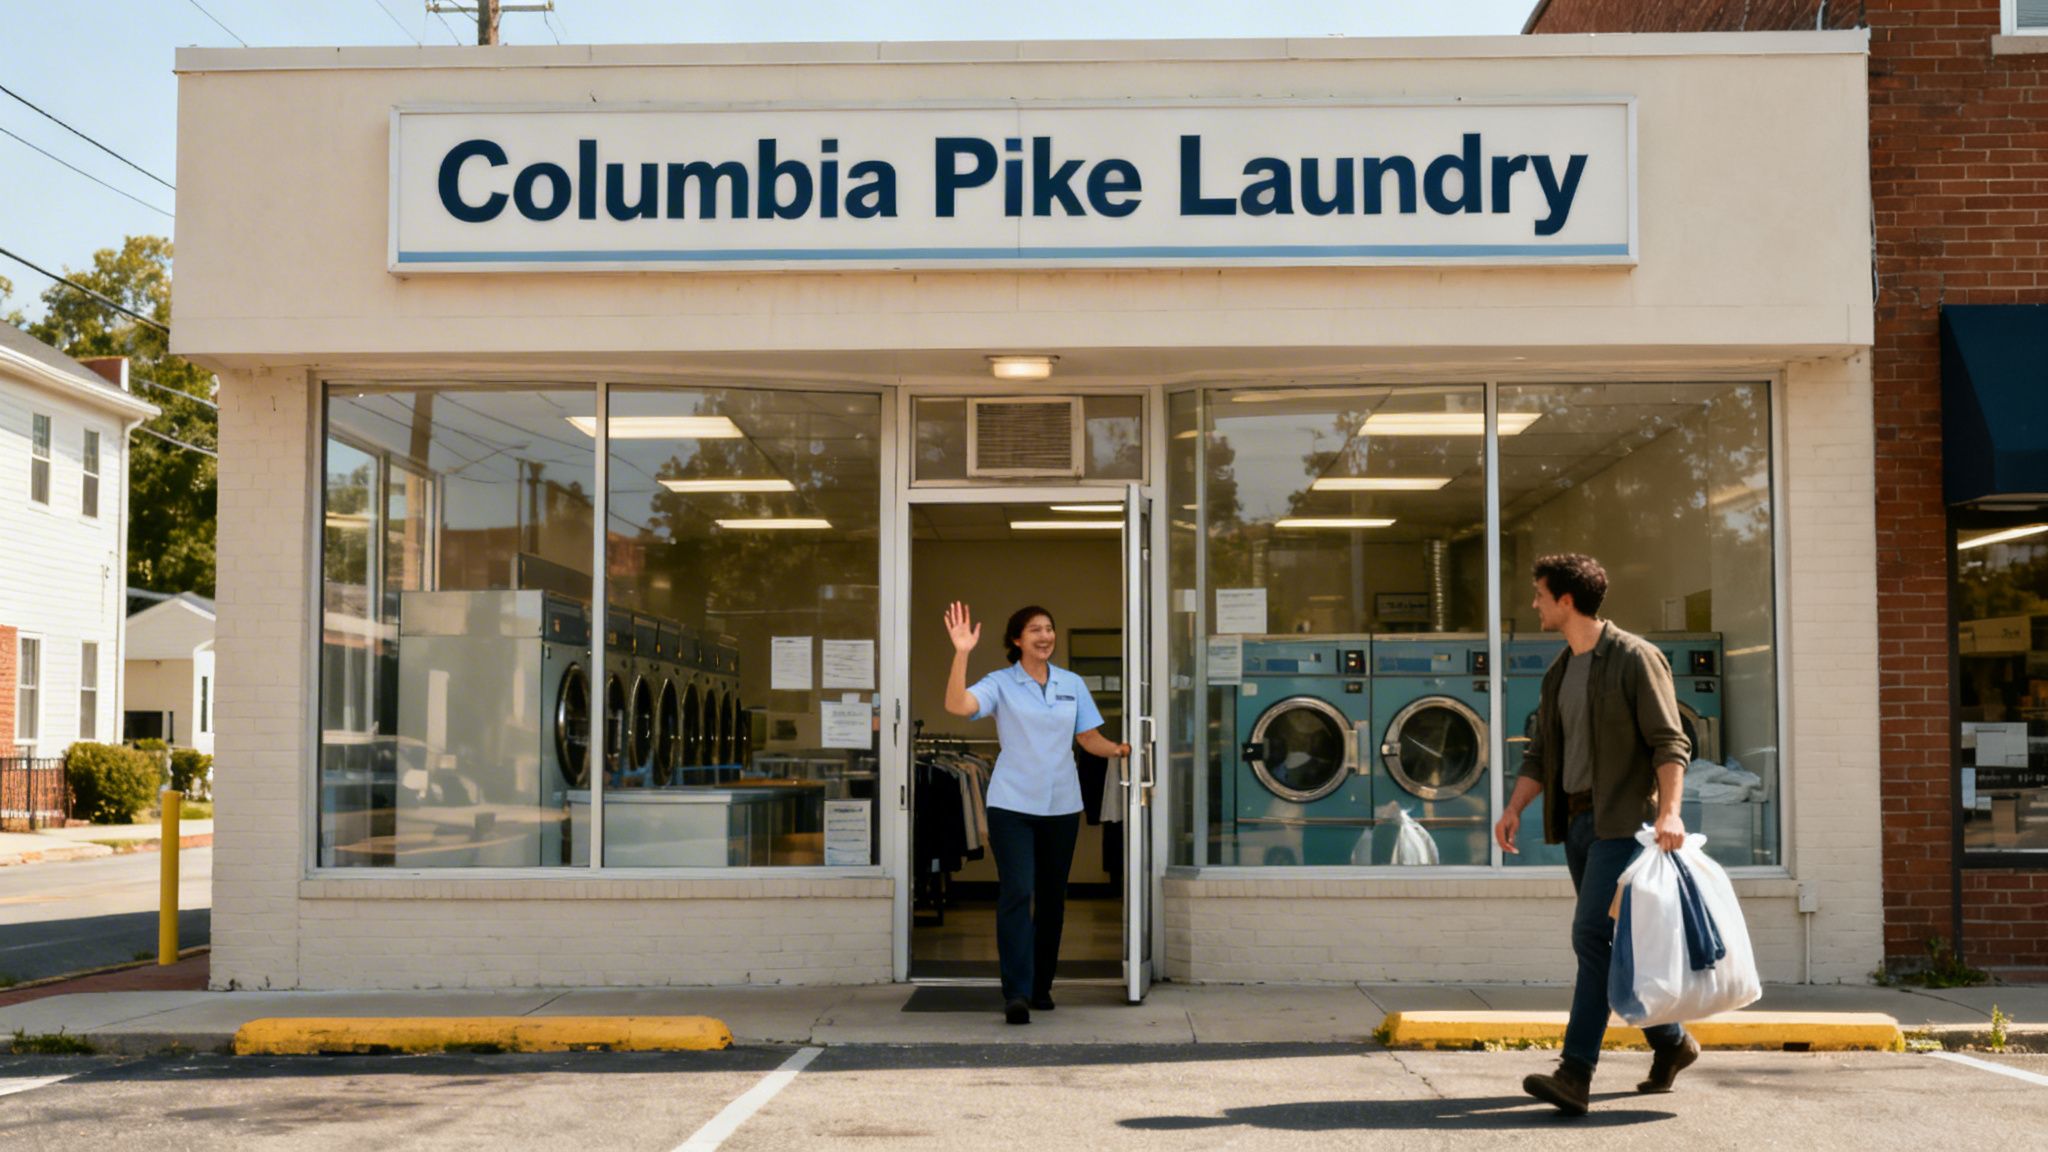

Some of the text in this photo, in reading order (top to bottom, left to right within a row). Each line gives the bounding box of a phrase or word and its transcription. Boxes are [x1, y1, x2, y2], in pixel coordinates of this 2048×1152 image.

[437, 132, 1589, 236] Columbia Pike Laundry
